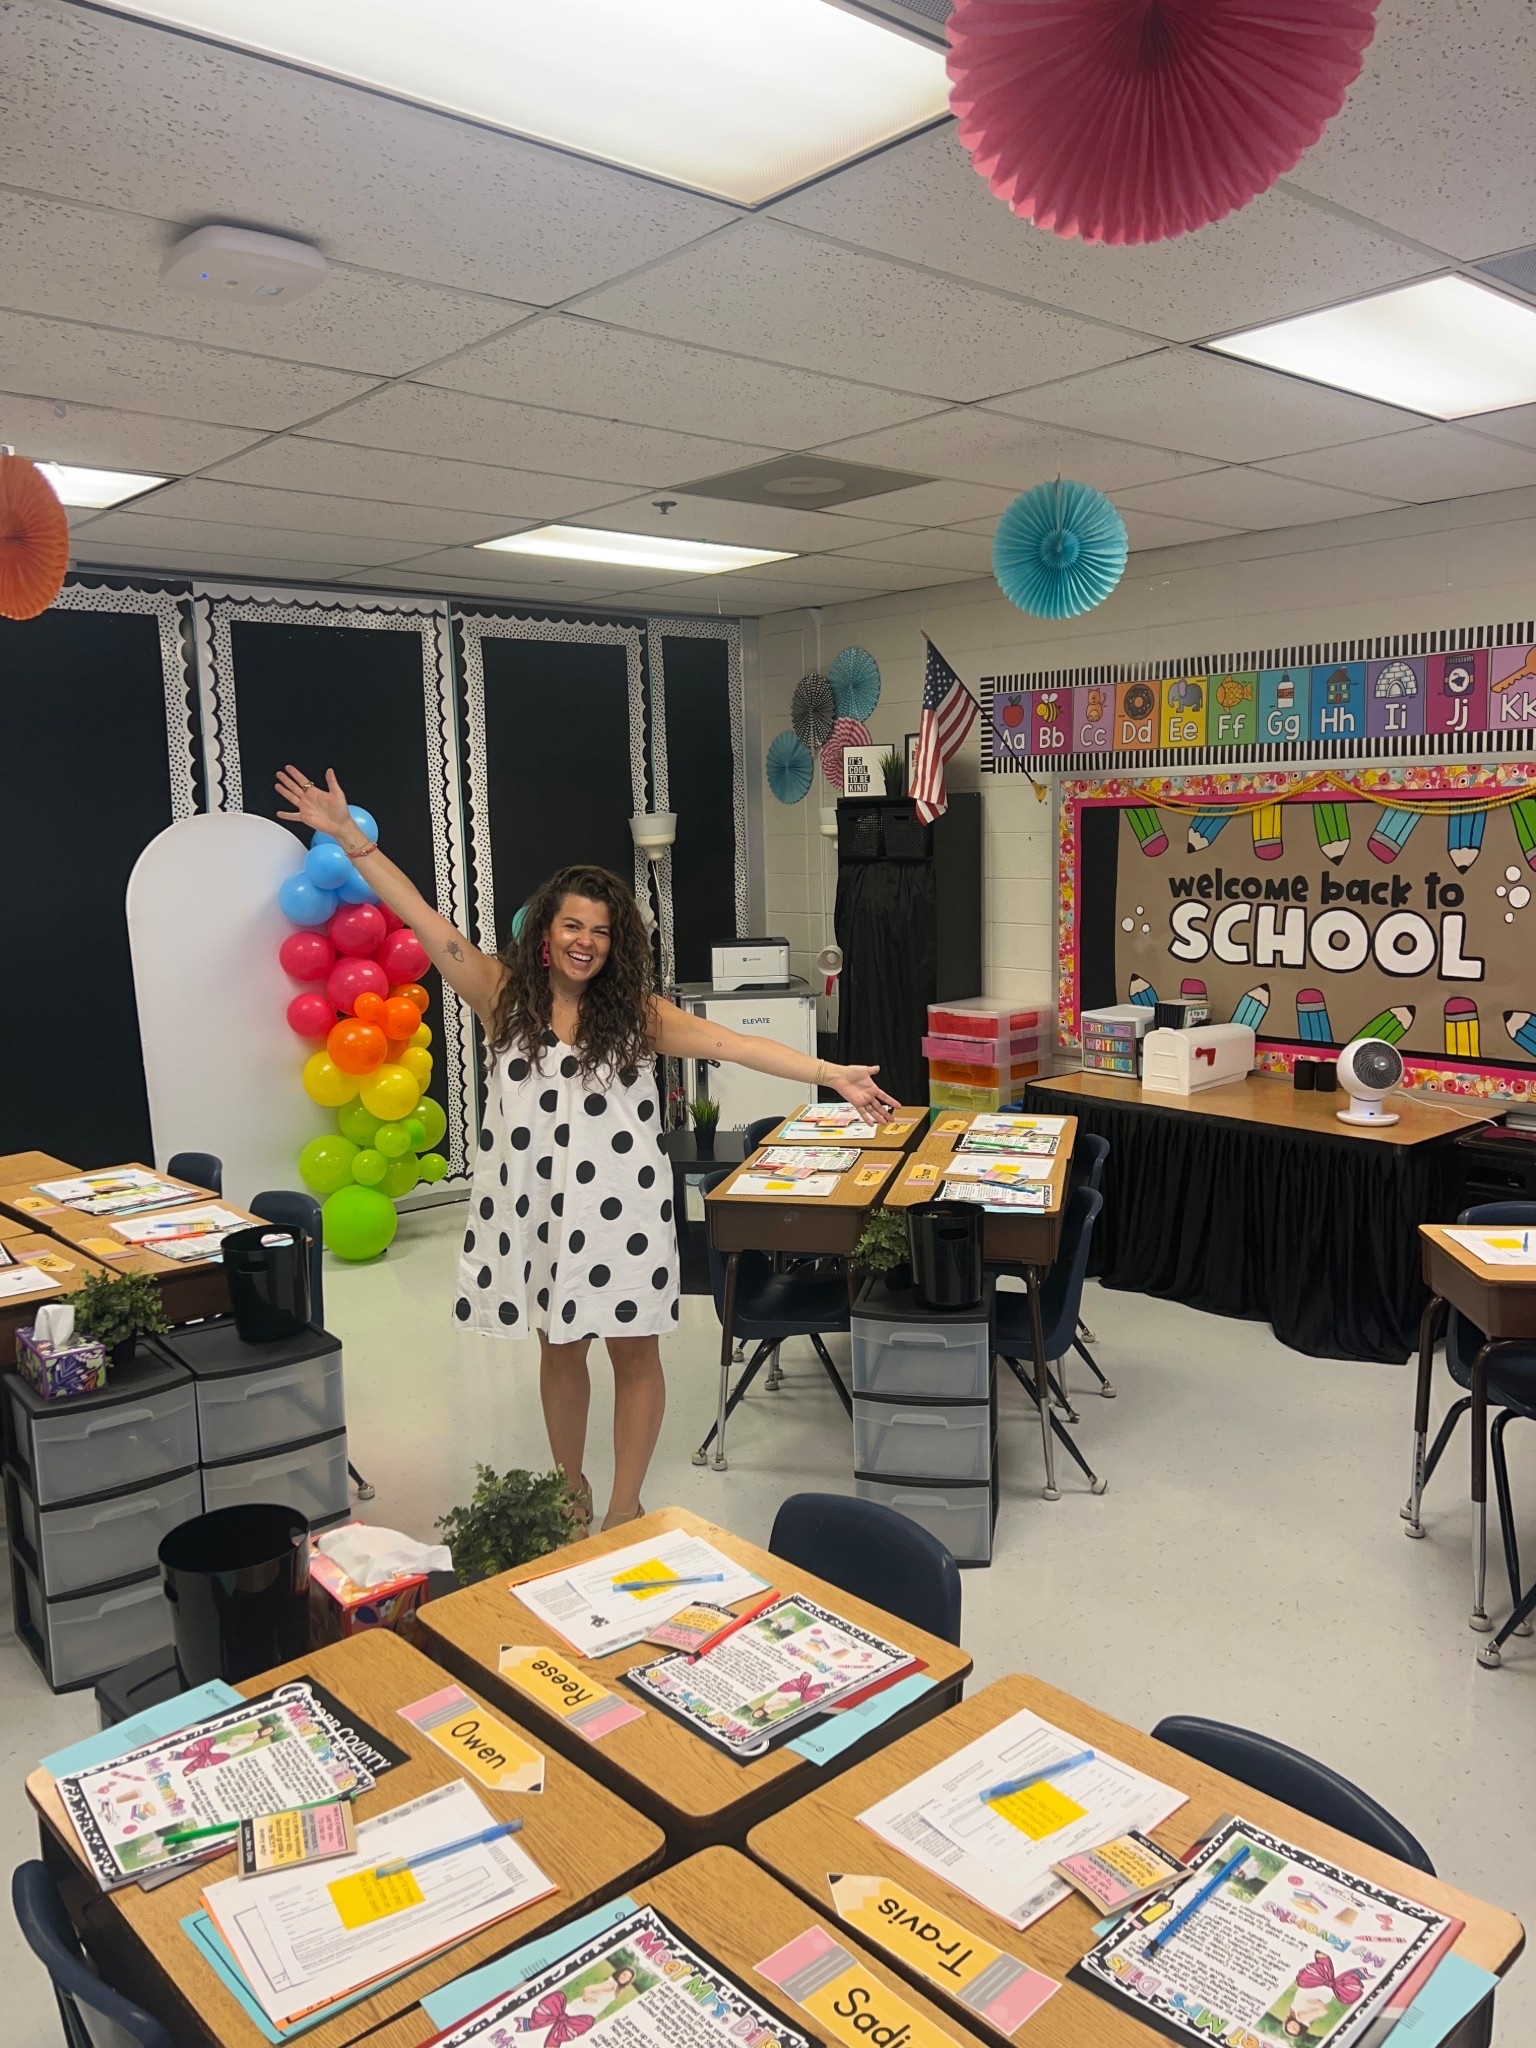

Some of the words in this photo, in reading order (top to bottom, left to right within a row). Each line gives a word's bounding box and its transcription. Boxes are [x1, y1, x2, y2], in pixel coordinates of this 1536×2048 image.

[1000, 729, 1025, 750] Aa
[1039, 726, 1065, 749] Bb
[1080, 724, 1107, 747] Cc
[1121, 720, 1152, 744] Dd
[1169, 717, 1199, 742] Ee
[1217, 714, 1246, 739] Ff
[1267, 710, 1300, 741] Gg
[1320, 706, 1355, 733] Hh
[1384, 703, 1407, 731] Ii
[1446, 698, 1469, 731] Jj
[1500, 692, 1536, 722] Kk
[849, 757, 861, 765] IT'S
[849, 766, 868, 774] COOL
[850, 775, 858, 783] TO
[860, 775, 868, 783] BE
[849, 784, 867, 792] KIND
[1169, 867, 1309, 902] welcome
[1321, 871, 1413, 908] back
[1425, 871, 1465, 910] to
[1167, 899, 1486, 982] SCHOOL
[742, 1017, 771, 1025] ELEVATE
[1085, 1038, 1132, 1054] WRITING
[531, 1659, 594, 1707] Reese
[336, 1727, 392, 1771] COUNTY
[451, 1720, 507, 1770] Owen
[877, 1897, 974, 1978] Travis
[633, 1929, 694, 1982] Meet
[681, 1976, 732, 2024] Mrs.
[1106, 1953, 1161, 1997] Dills
[833, 1988, 918, 2048] Sadi
[1165, 1988, 1229, 2035] Mrs.
